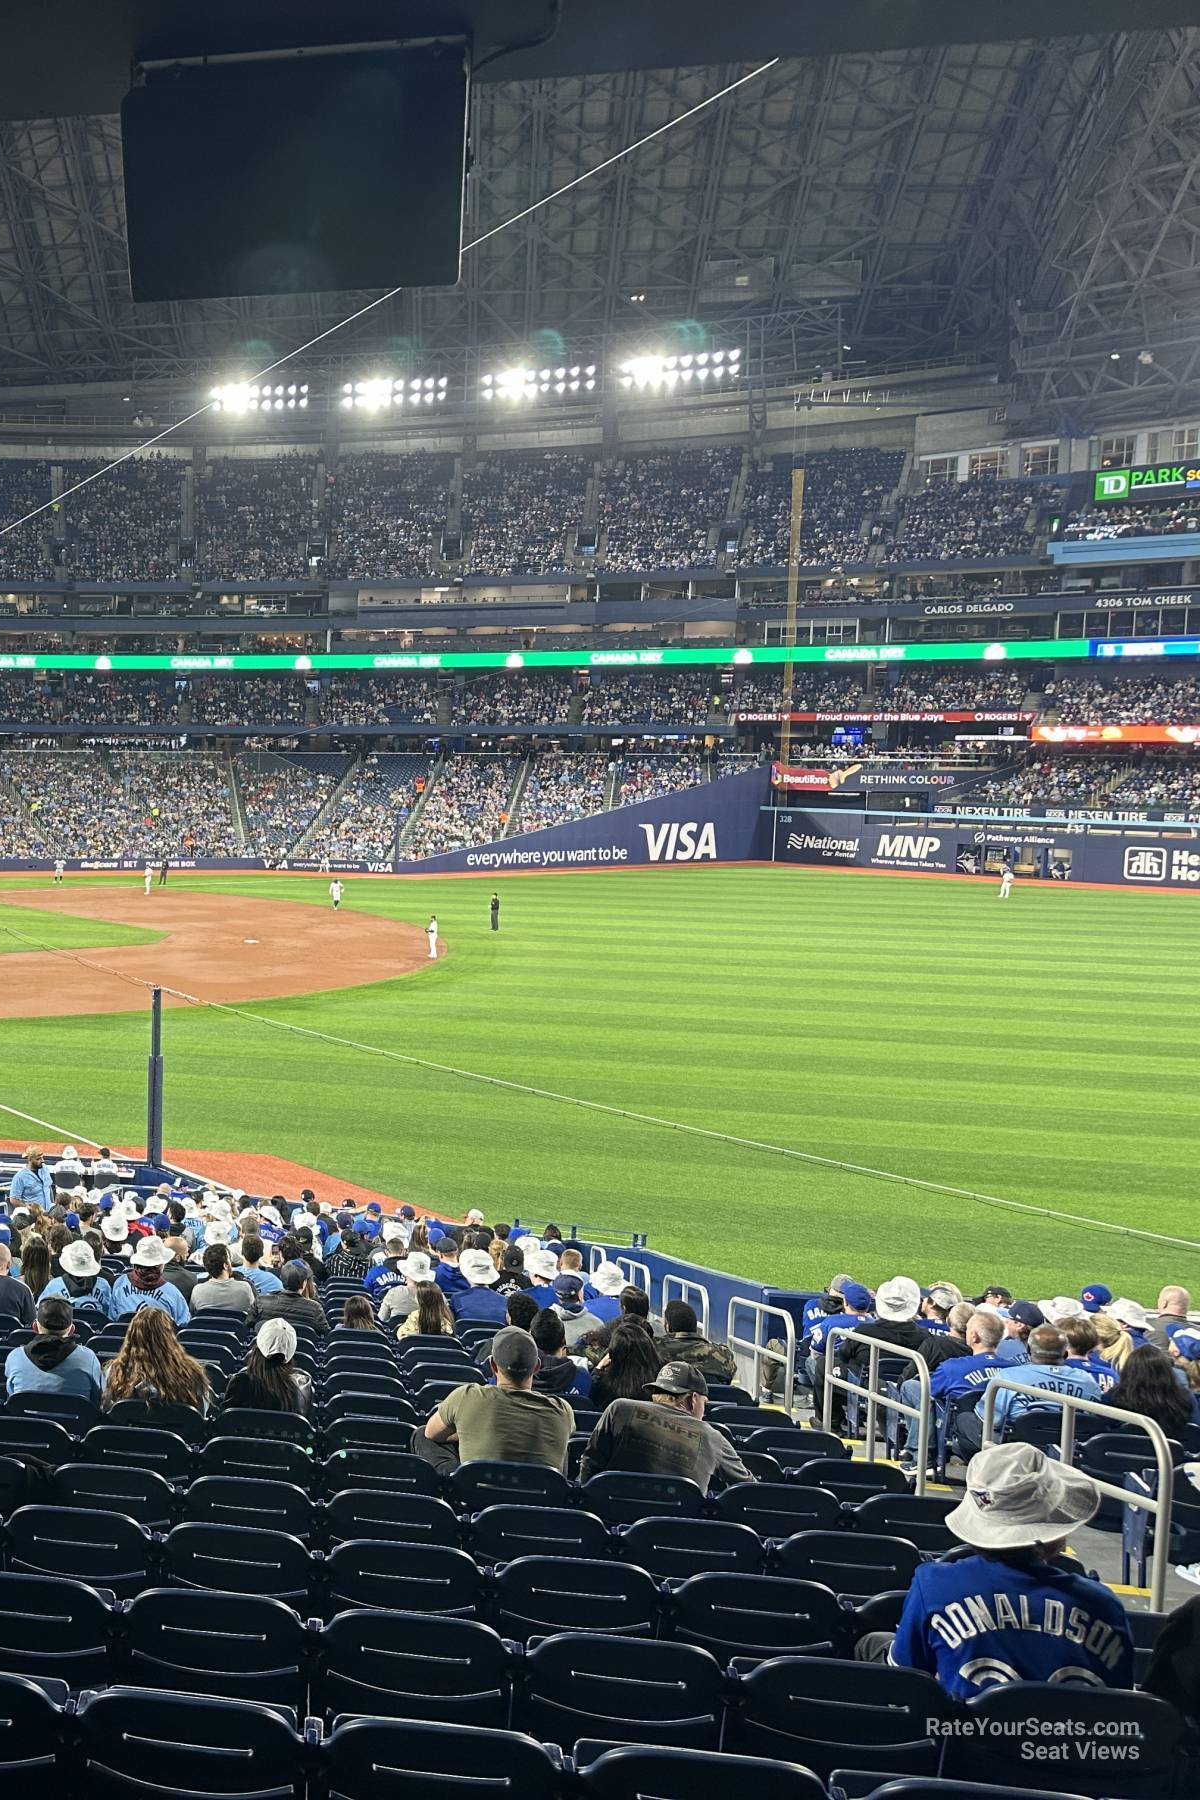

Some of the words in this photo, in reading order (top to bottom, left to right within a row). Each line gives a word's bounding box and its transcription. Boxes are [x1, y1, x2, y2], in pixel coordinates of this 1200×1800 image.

[1131, 466, 1185, 487] PARK
[1099, 475, 1126, 494] TD
[1095, 599, 1123, 608] 4306
[1126, 597, 1151, 607] TOM
[1154, 595, 1192, 605] CHEEK
[924, 605, 963, 615] CARLOS
[966, 603, 1014, 613] DELGADO
[590, 653, 638, 664] CANADA
[825, 649, 877, 660] CANADA
[170, 657, 211, 668] CANADA
[373, 656, 417, 667] CANADA
[816, 713, 843, 721] Proud
[873, 713, 883, 721] of
[884, 713, 899, 721] the
[900, 713, 920, 721] Blue
[921, 714, 944, 723] Jays
[860, 775, 907, 784] RETHINK
[909, 775, 954, 785] COLOUR
[956, 806, 997, 817] NEXEN
[1000, 807, 1030, 818] TIRE
[1068, 809, 1110, 821] NEXEN
[1111, 812, 1147, 822] TIRE
[638, 822, 717, 861] VISA
[987, 834, 1023, 844] Pathways
[1024, 835, 1055, 844] Alliance
[877, 834, 941, 859] MNP
[466, 849, 541, 867] everywhere
[542, 850, 565, 865] you
[567, 848, 596, 861] want
[598, 847, 611, 860] to
[612, 846, 628, 860] be
[81, 861, 118, 869] theScore
[366, 862, 393, 872] VISA
[636, 1409, 699, 1439] BANFF
[931, 1594, 1124, 1670] DONALDSON
